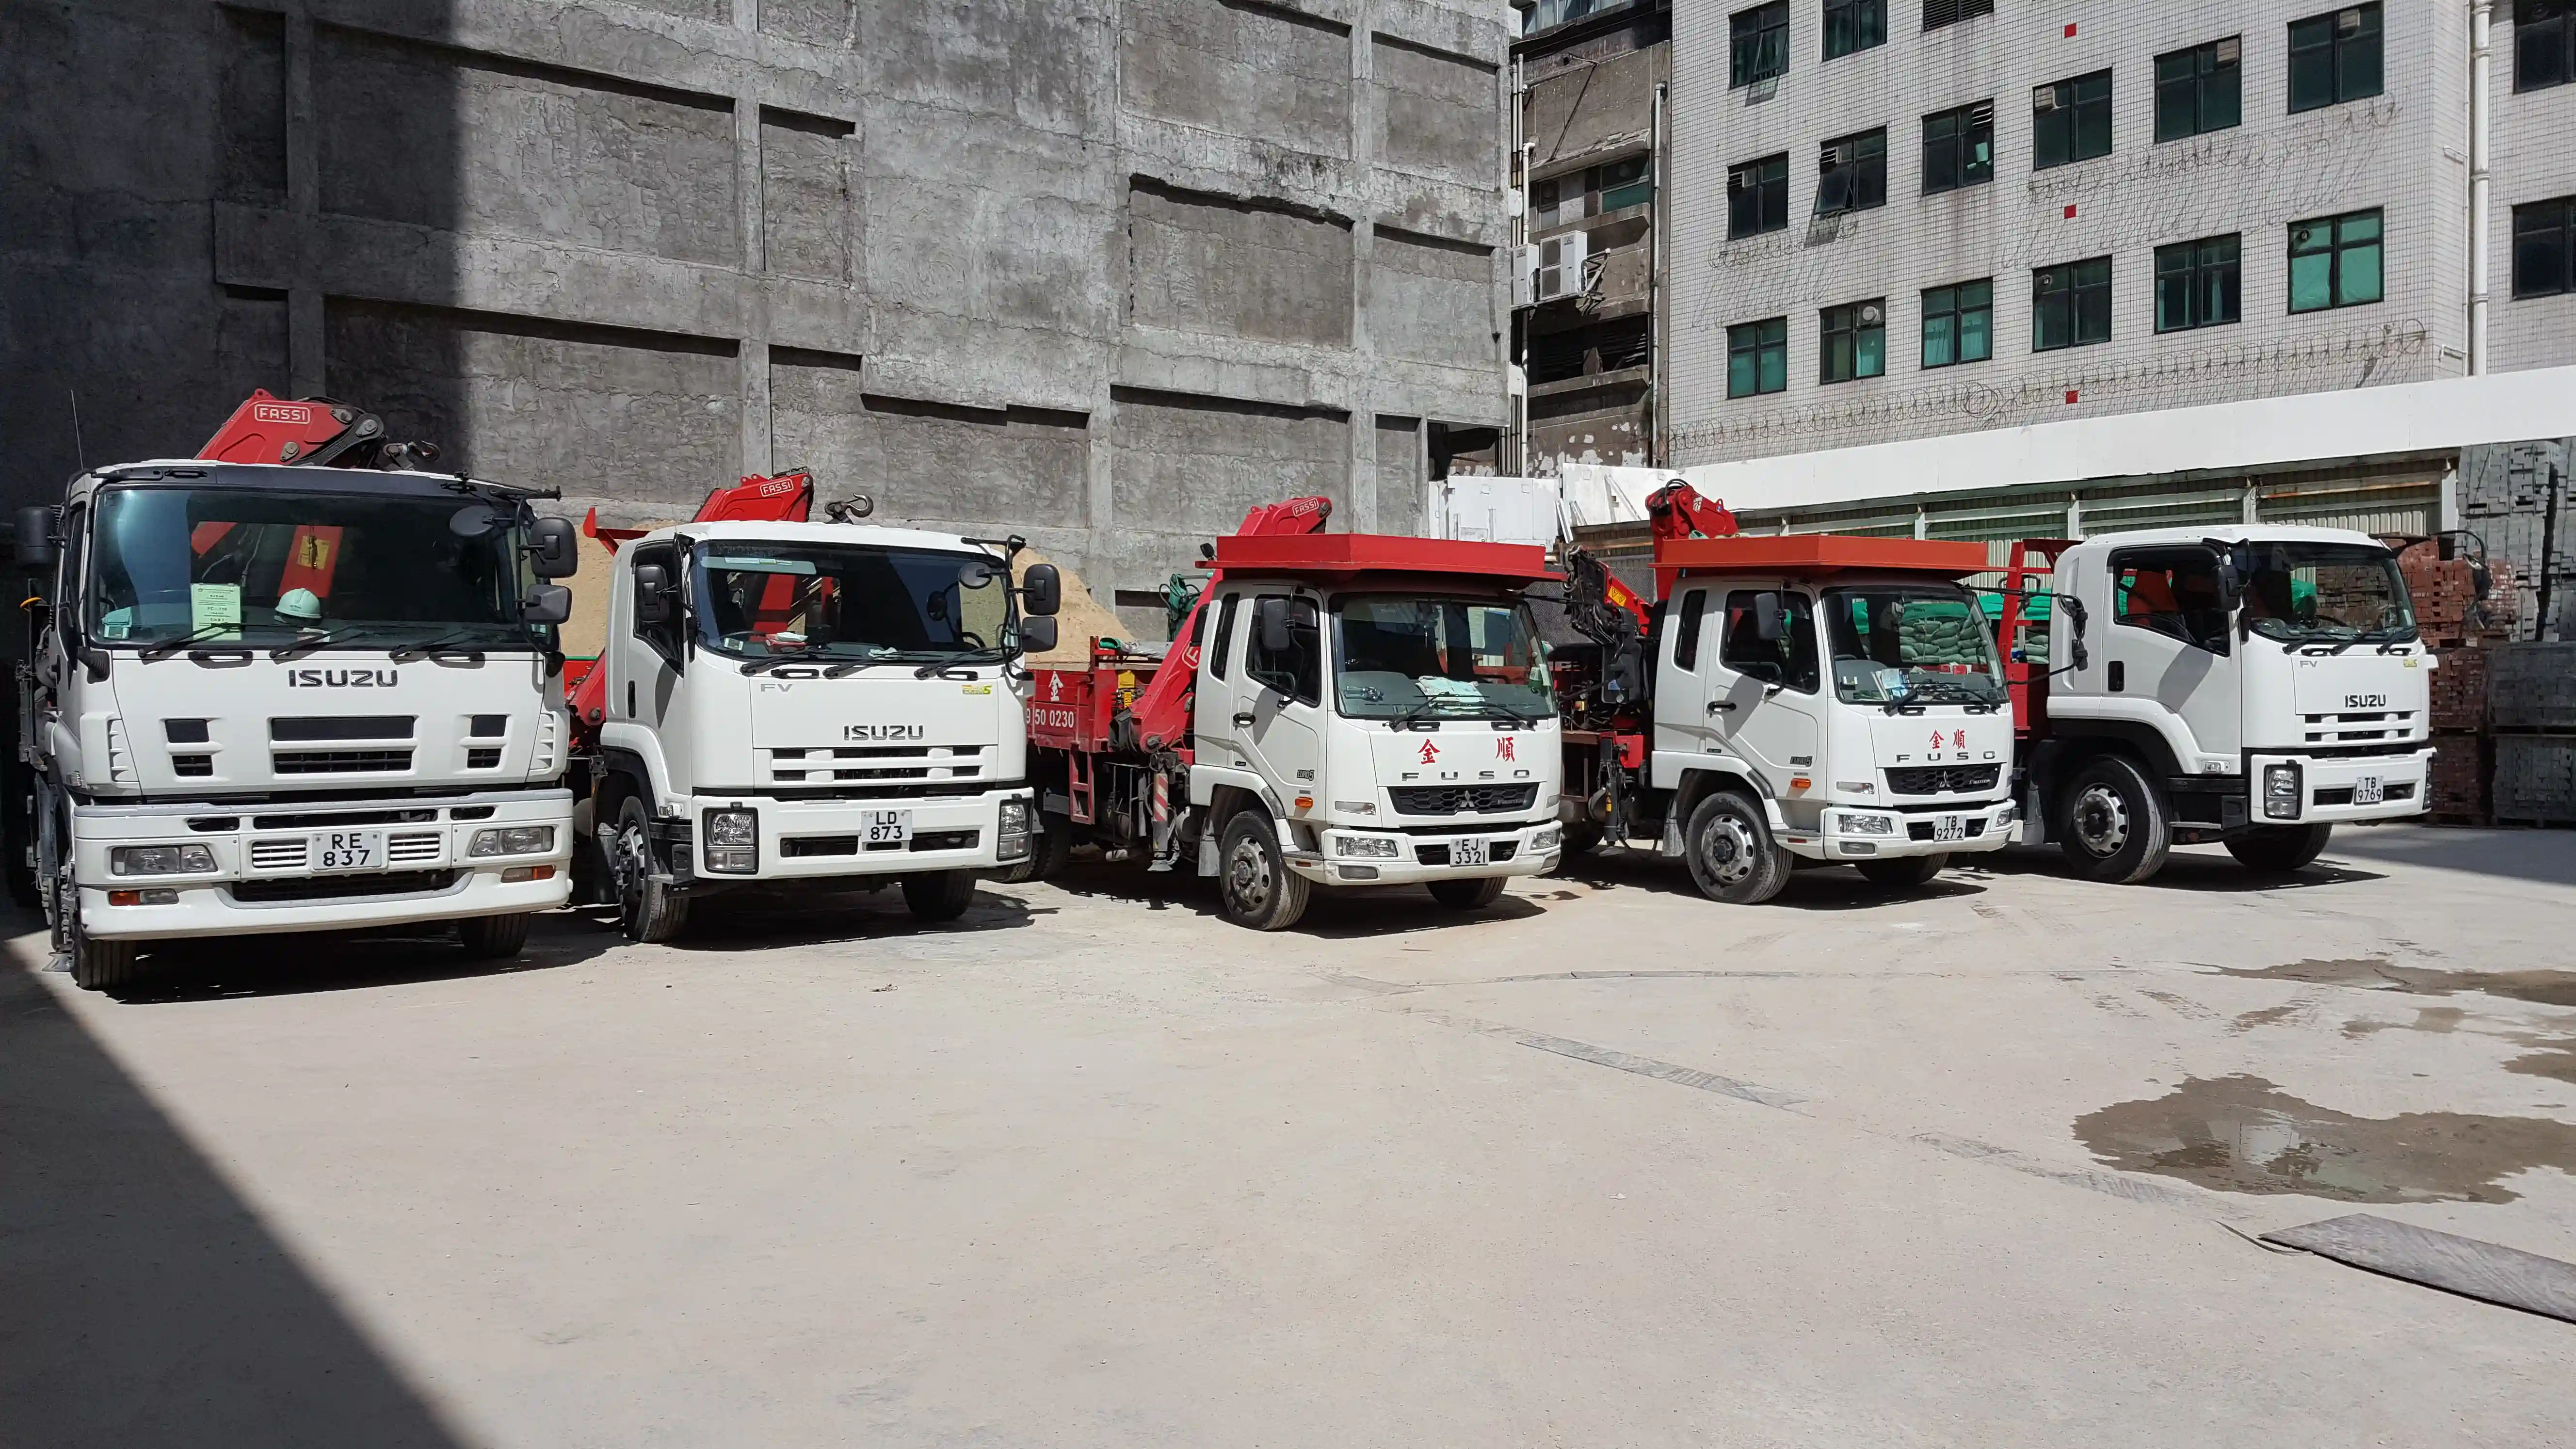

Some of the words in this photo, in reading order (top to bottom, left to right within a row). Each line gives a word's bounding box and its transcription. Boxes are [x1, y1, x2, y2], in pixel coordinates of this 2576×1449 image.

[260, 408, 305, 421] FASSI
[763, 482, 791, 494] FASSI
[1294, 500, 1317, 515] FASSI
[289, 669, 398, 687] ISUZU
[760, 683, 793, 692] FV
[1048, 671, 1063, 701] 金
[2345, 694, 2386, 708] ISUZU
[1049, 710, 1074, 728] 0230
[844, 725, 923, 741] ISUZU
[1896, 751, 1996, 763] FUSO
[1401, 769, 1530, 782] FUSO
[2365, 777, 2376, 789] TB
[2358, 789, 2382, 801] 9769
[876, 811, 897, 825] LD
[1945, 816, 1957, 827] TB
[870, 825, 902, 840] 873
[1936, 827, 1963, 840] 9272
[332, 833, 363, 850] RE
[1462, 838, 1479, 851] EJ
[323, 850, 370, 867] 837
[1455, 851, 1485, 864] 3321
